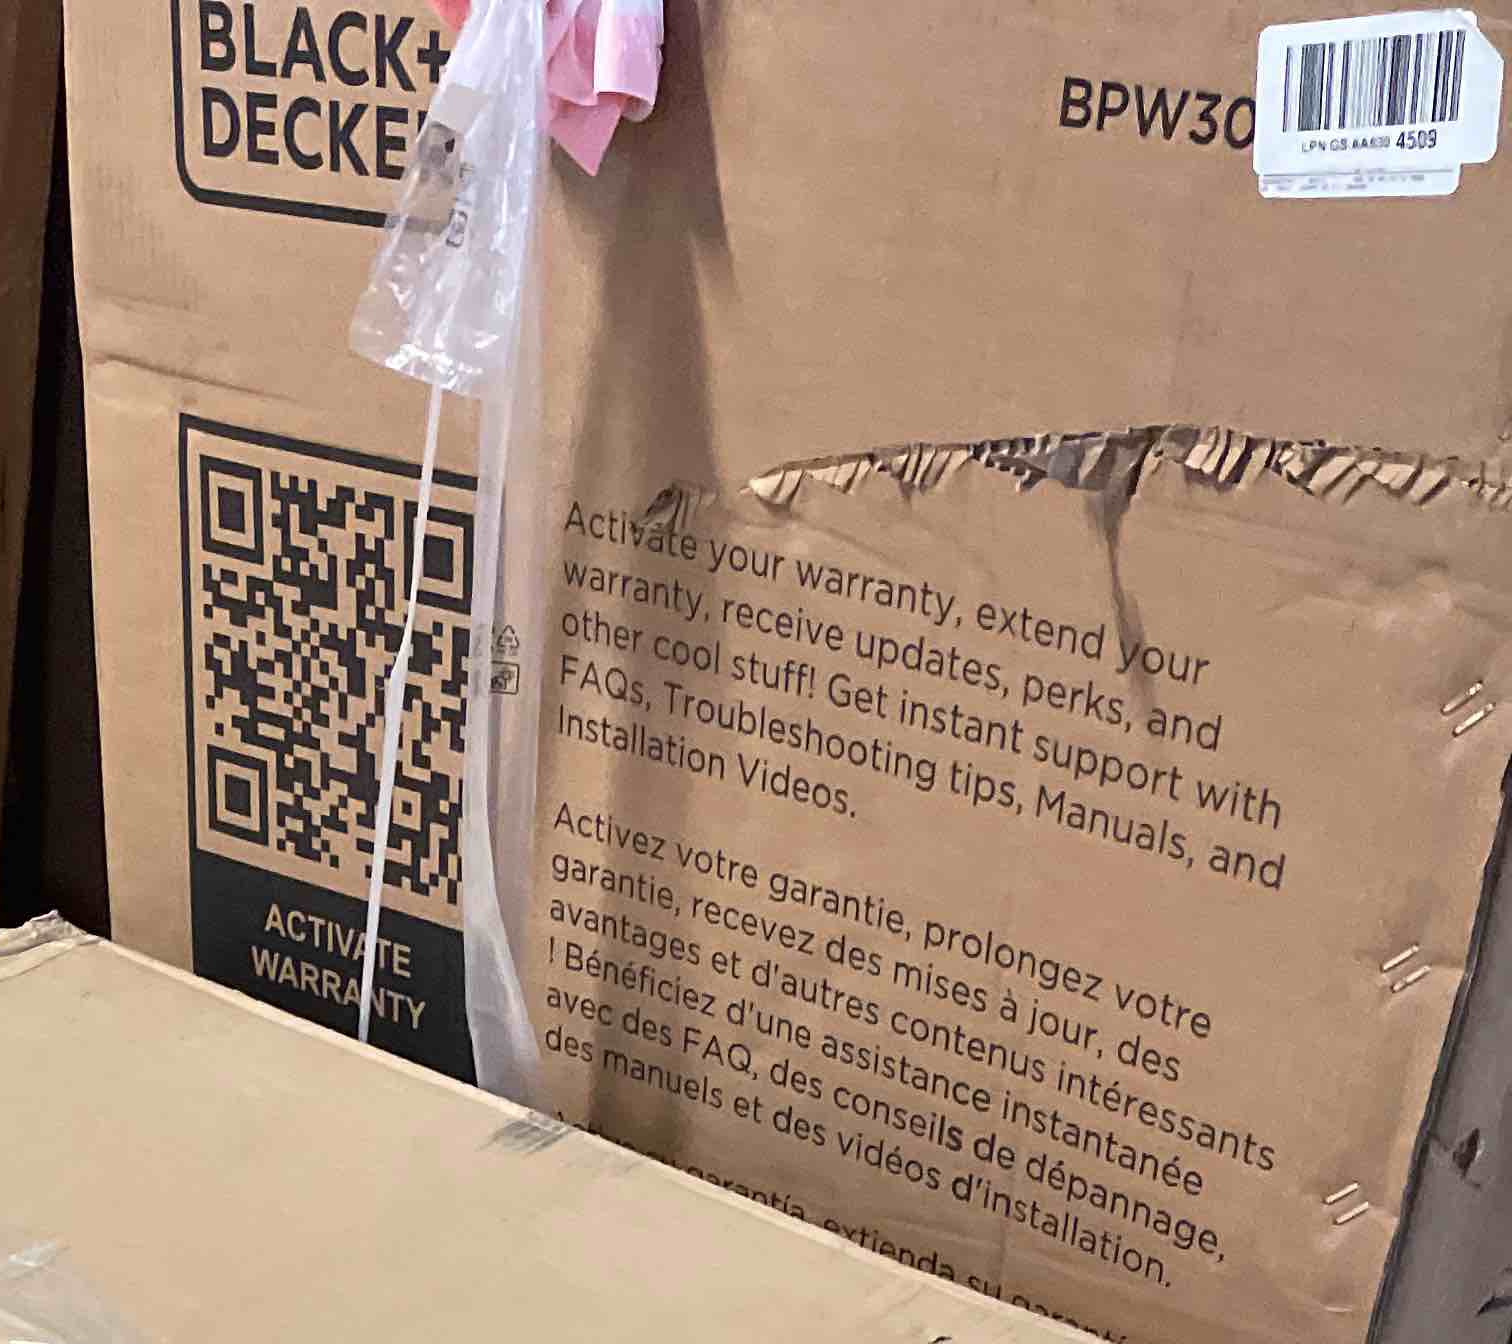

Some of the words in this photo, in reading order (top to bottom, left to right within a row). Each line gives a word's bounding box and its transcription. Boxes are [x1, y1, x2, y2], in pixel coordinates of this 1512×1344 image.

[200, 0, 452, 93] BLACK+
[201, 86, 431, 181] DECKE
[563, 559, 710, 624] warranty,
[720, 598, 844, 652] receive
[854, 629, 1009, 699] updates,
[1022, 672, 1132, 733] perks,
[1146, 706, 1224, 753] and
[564, 500, 697, 561] Activate
[707, 537, 785, 582] your
[796, 559, 962, 629] warranty,
[975, 601, 1106, 661] extend
[1116, 640, 1211, 686] your
[557, 703, 726, 781] Installation
[736, 752, 857, 819] Videos.
[559, 653, 652, 713] FAQs,
[663, 680, 938, 793] Troubleshooting
[949, 759, 1024, 817] tips,
[1035, 784, 1196, 870] Manuals,
[1208, 843, 1288, 892] and
[561, 609, 644, 652] other
[652, 633, 721, 675] cool
[730, 651, 817, 699] stuff!
[827, 672, 889, 720] Get
[898, 689, 1025, 755] instant
[1032, 733, 1184, 803] support
[1196, 778, 1282, 830] with
[250, 944, 427, 1031] WARRANTY
[551, 852, 682, 917] garantie,
[691, 894, 816, 956] recevez
[824, 935, 883, 979] des
[892, 960, 988, 1013] mises
[998, 988, 1018, 1023] à
[1025, 997, 1104, 1060] jour,
[1116, 1034, 1181, 1082] des
[553, 802, 666, 861] Activez
[676, 842, 759, 889] votre
[768, 870, 912, 942] garantie,
[922, 919, 1104, 1001] prolongez
[1115, 982, 1213, 1039] votre
[546, 985, 614, 1028] avec
[621, 1006, 674, 1049] des
[681, 1026, 759, 1081] FAQ,
[769, 1058, 823, 1101] des
[832, 1084, 963, 1153] conseils
[972, 1131, 1017, 1170] de
[1025, 1151, 1226, 1265] dépannage,
[550, 898, 702, 965] avantages
[710, 950, 742, 980] et
[751, 958, 880, 1026] d'autres
[890, 1009, 1047, 1083] contenus
[1056, 1060, 1277, 1173] intéressants
[564, 941, 718, 1017] Bénéficiez
[726, 997, 812, 1050] d'une
[820, 1033, 992, 1113] assistance
[1000, 1089, 1204, 1197] instantanée
[545, 1025, 594, 1063] des
[602, 1048, 724, 1111] manuels
[732, 1094, 763, 1125] et
[772, 1105, 827, 1148] des
[836, 1130, 942, 1192] vidéos
[951, 1172, 1172, 1290] d'installation.
